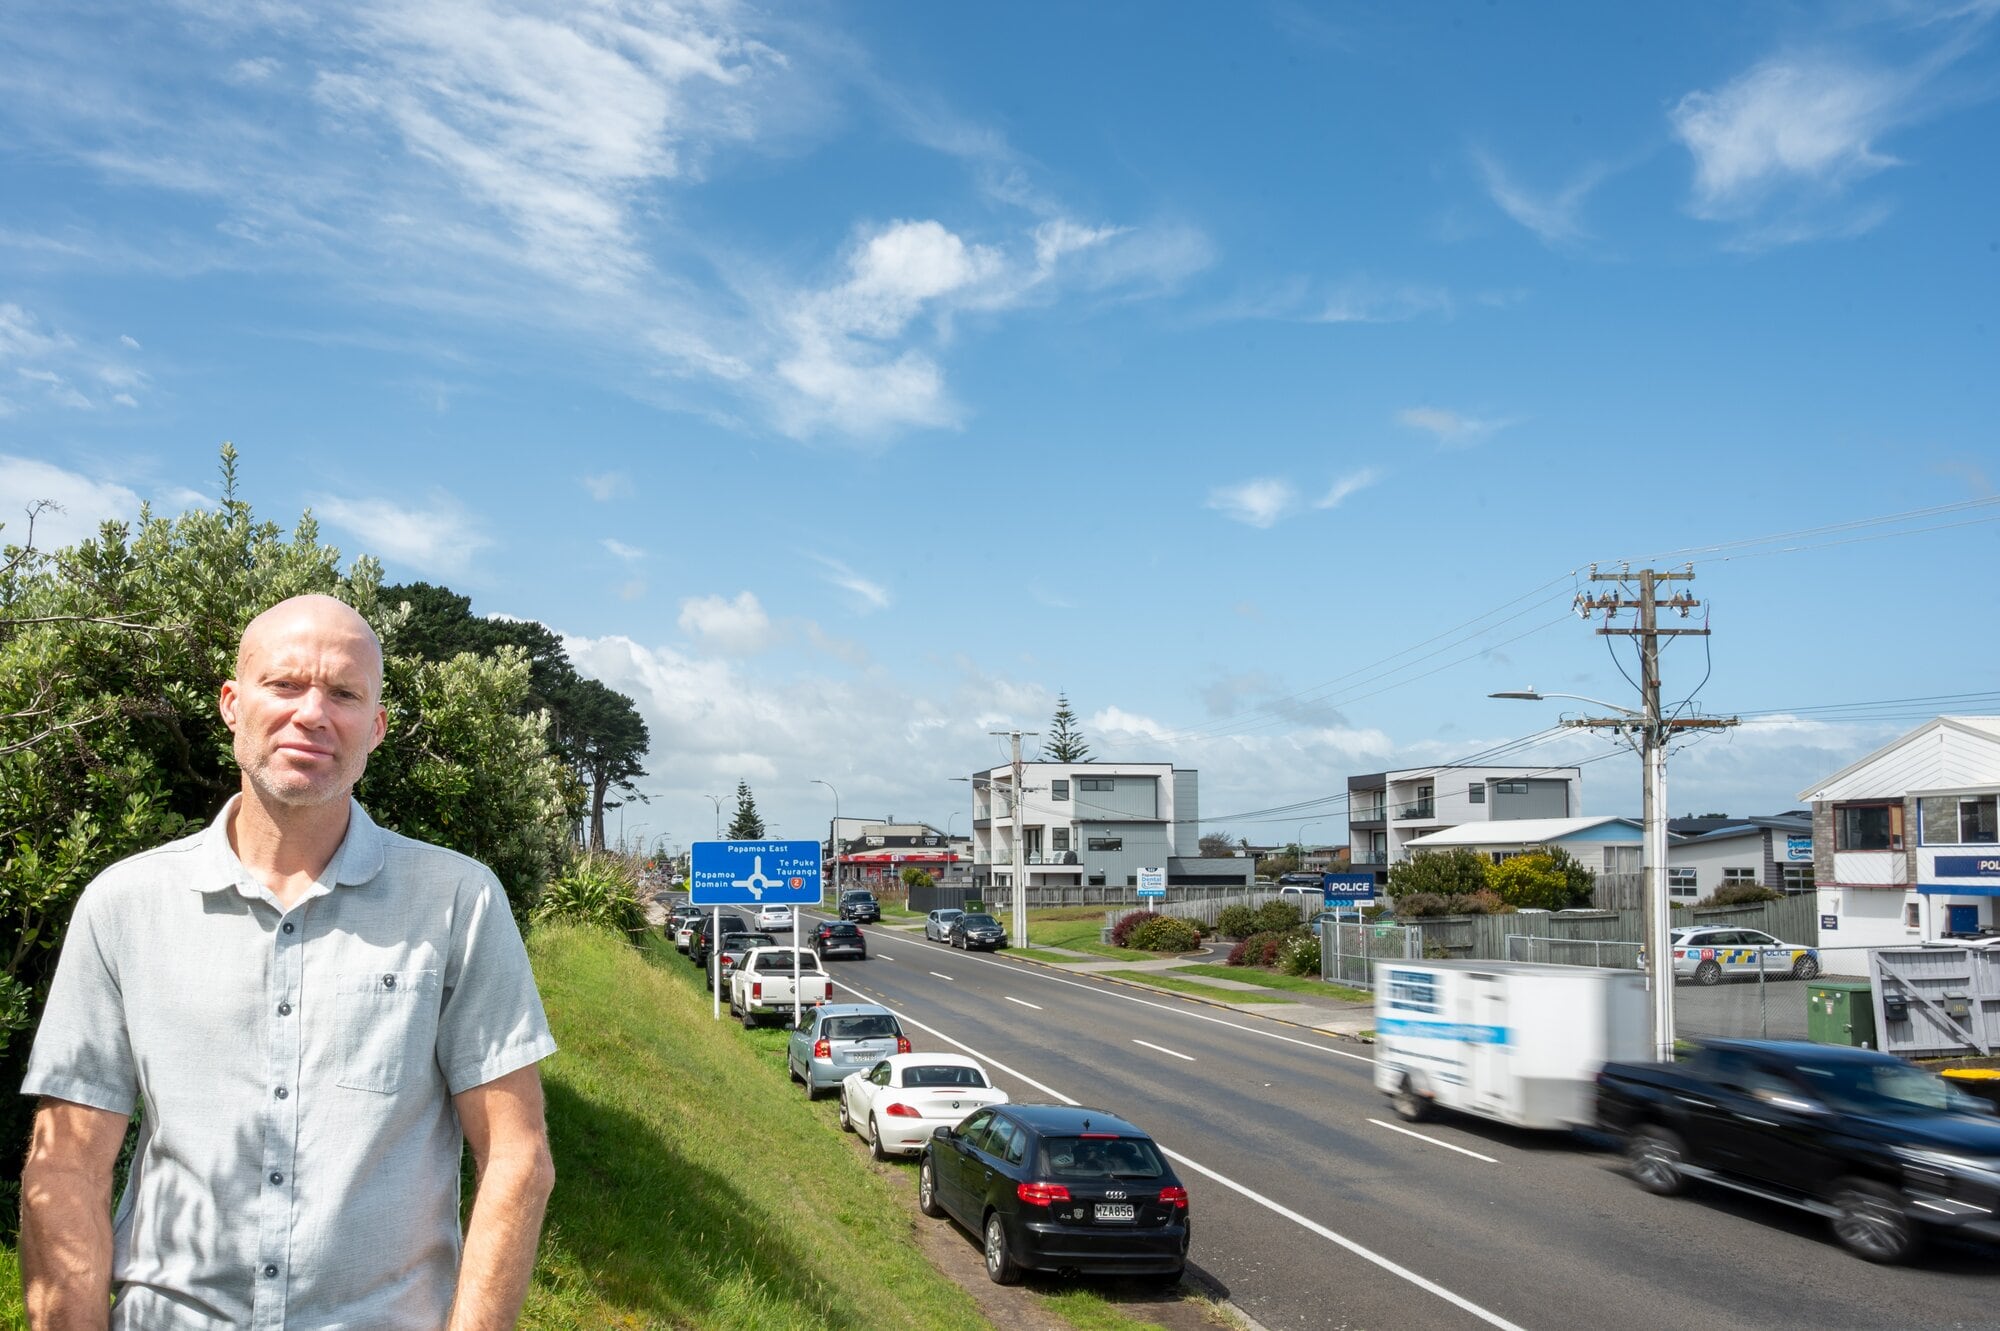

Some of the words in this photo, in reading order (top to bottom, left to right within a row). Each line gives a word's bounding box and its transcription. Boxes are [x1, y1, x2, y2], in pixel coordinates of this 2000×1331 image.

[1788, 840, 1812, 848] Dental
[728, 845, 766, 853] Papamoa
[695, 871, 735, 879] Papamoa
[776, 868, 817, 876] Tauranga
[1332, 882, 1370, 891] POLICE
[1763, 949, 1791, 957] OLICE
[1095, 1204, 1133, 1217] MZA856
